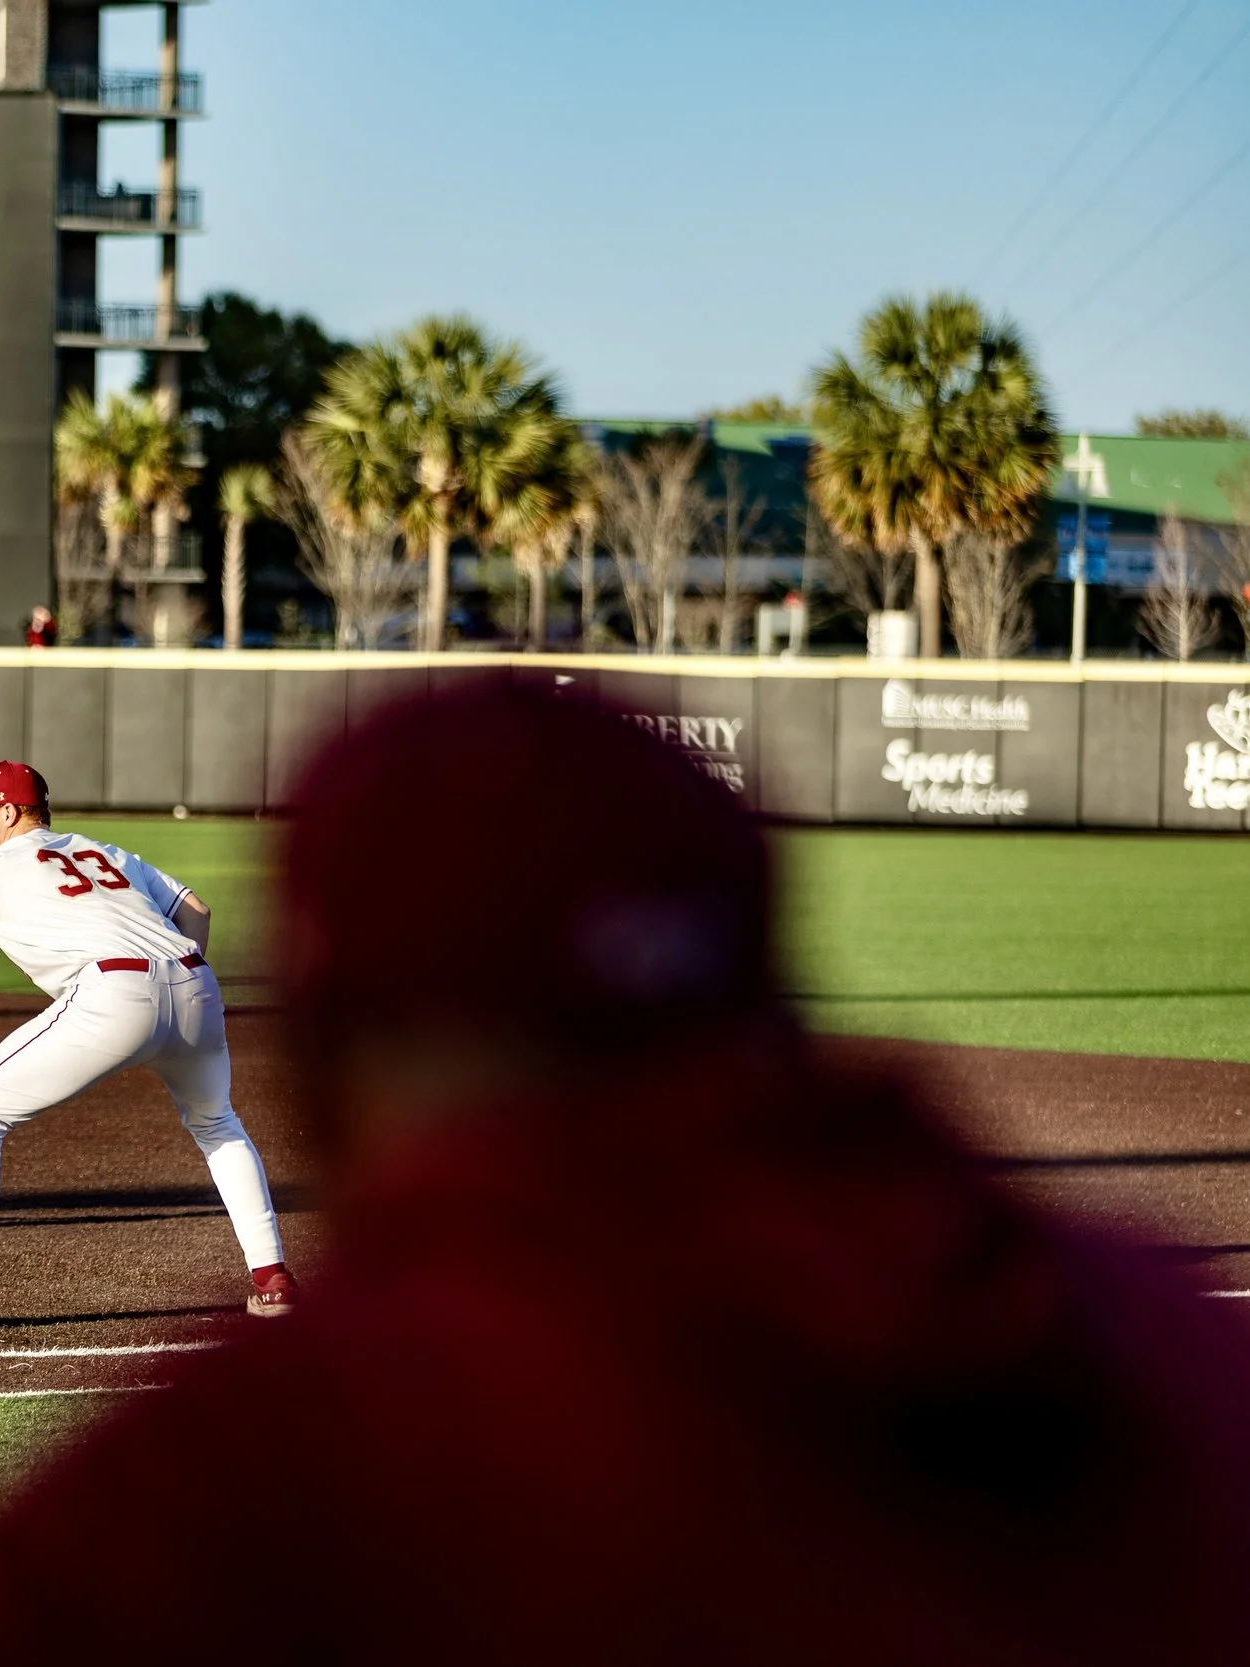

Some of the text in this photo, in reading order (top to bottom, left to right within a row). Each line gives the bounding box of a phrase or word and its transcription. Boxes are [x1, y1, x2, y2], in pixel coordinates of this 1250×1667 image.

[882, 738, 995, 791] Sports
[908, 781, 1029, 815] Medicine
[37, 848, 131, 897] 33
